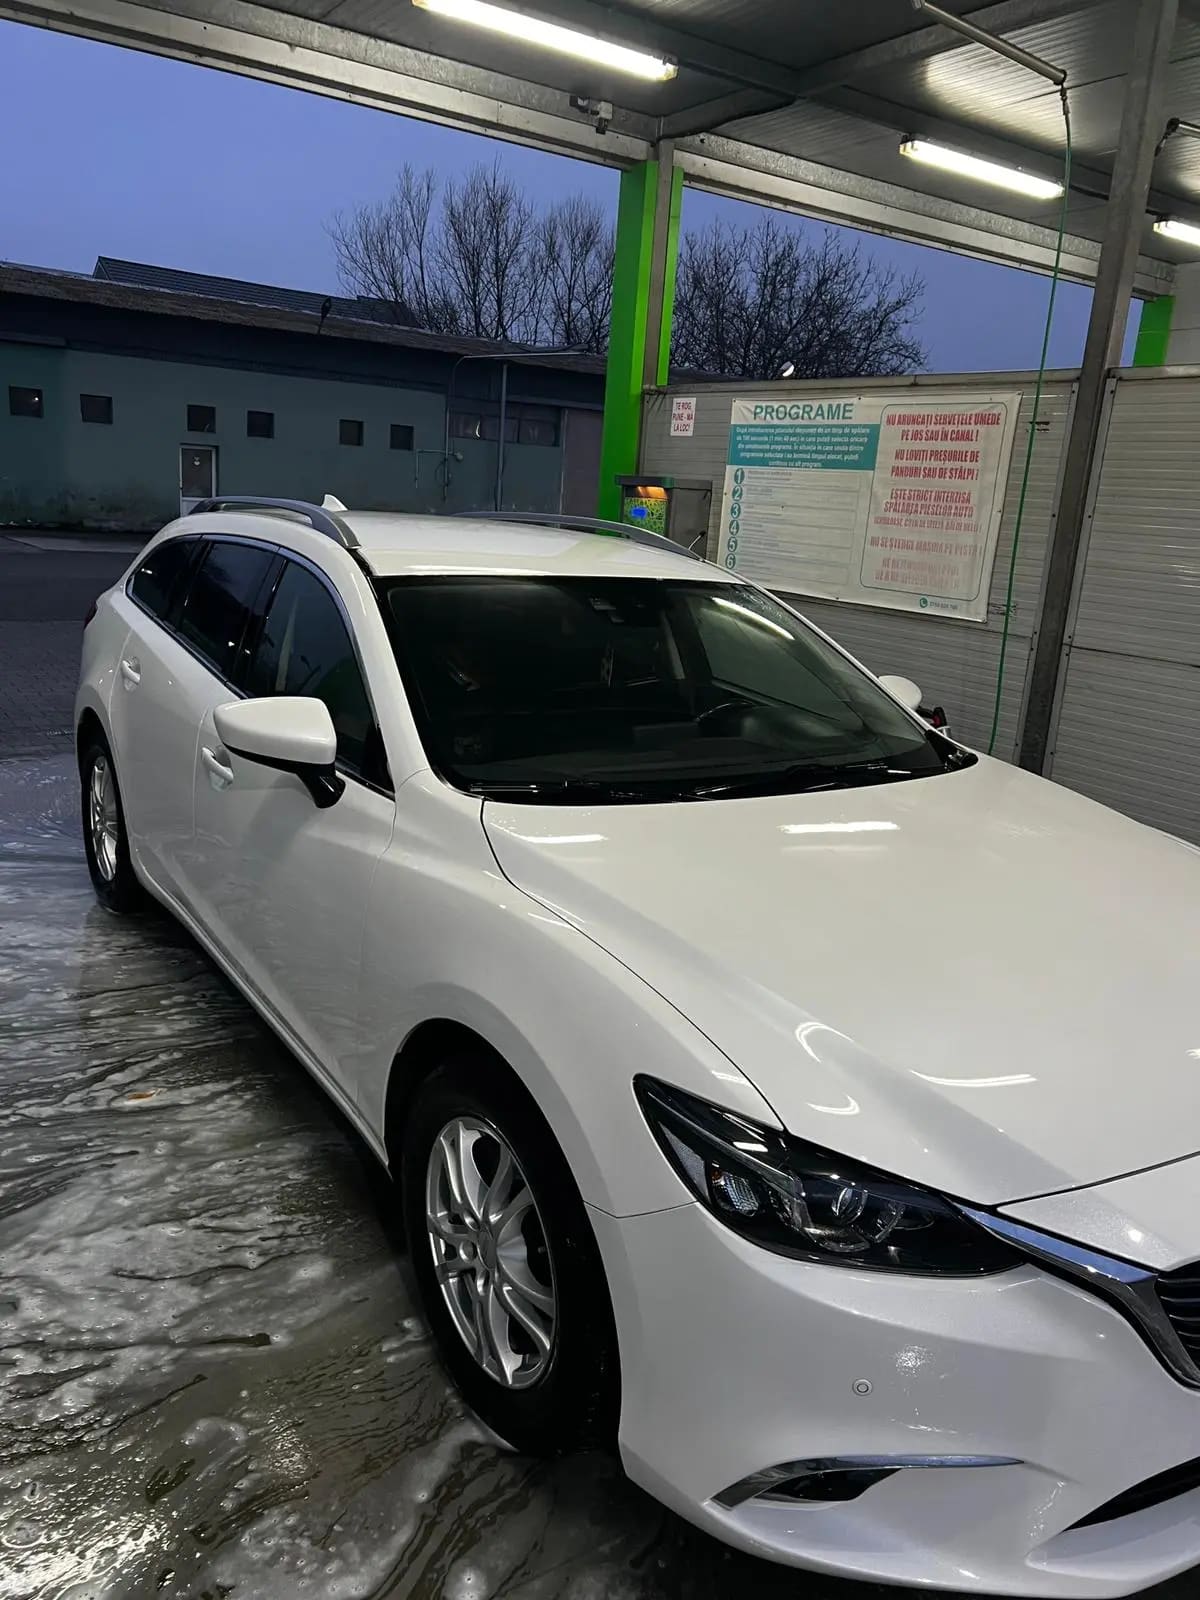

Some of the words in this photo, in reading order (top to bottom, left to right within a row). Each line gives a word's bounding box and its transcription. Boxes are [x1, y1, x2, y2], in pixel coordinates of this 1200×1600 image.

[676, 402, 680, 410] TE
[753, 403, 854, 420] PROGRAME
[886, 414, 896, 426] NU
[974, 412, 1001, 426] UMEDE
[901, 430, 910, 441] PE
[911, 430, 924, 441] JOS
[924, 430, 940, 441] SAU
[941, 427, 950, 441] ÎN
[950, 430, 974, 442] CANAL
[895, 449, 905, 461] NU
[905, 450, 929, 464] LOVIȚI
[969, 451, 980, 463] DE
[922, 466, 937, 479] SAU
[938, 467, 949, 479] DE
[891, 488, 907, 501] ESTE
[908, 489, 933, 502] STRICT
